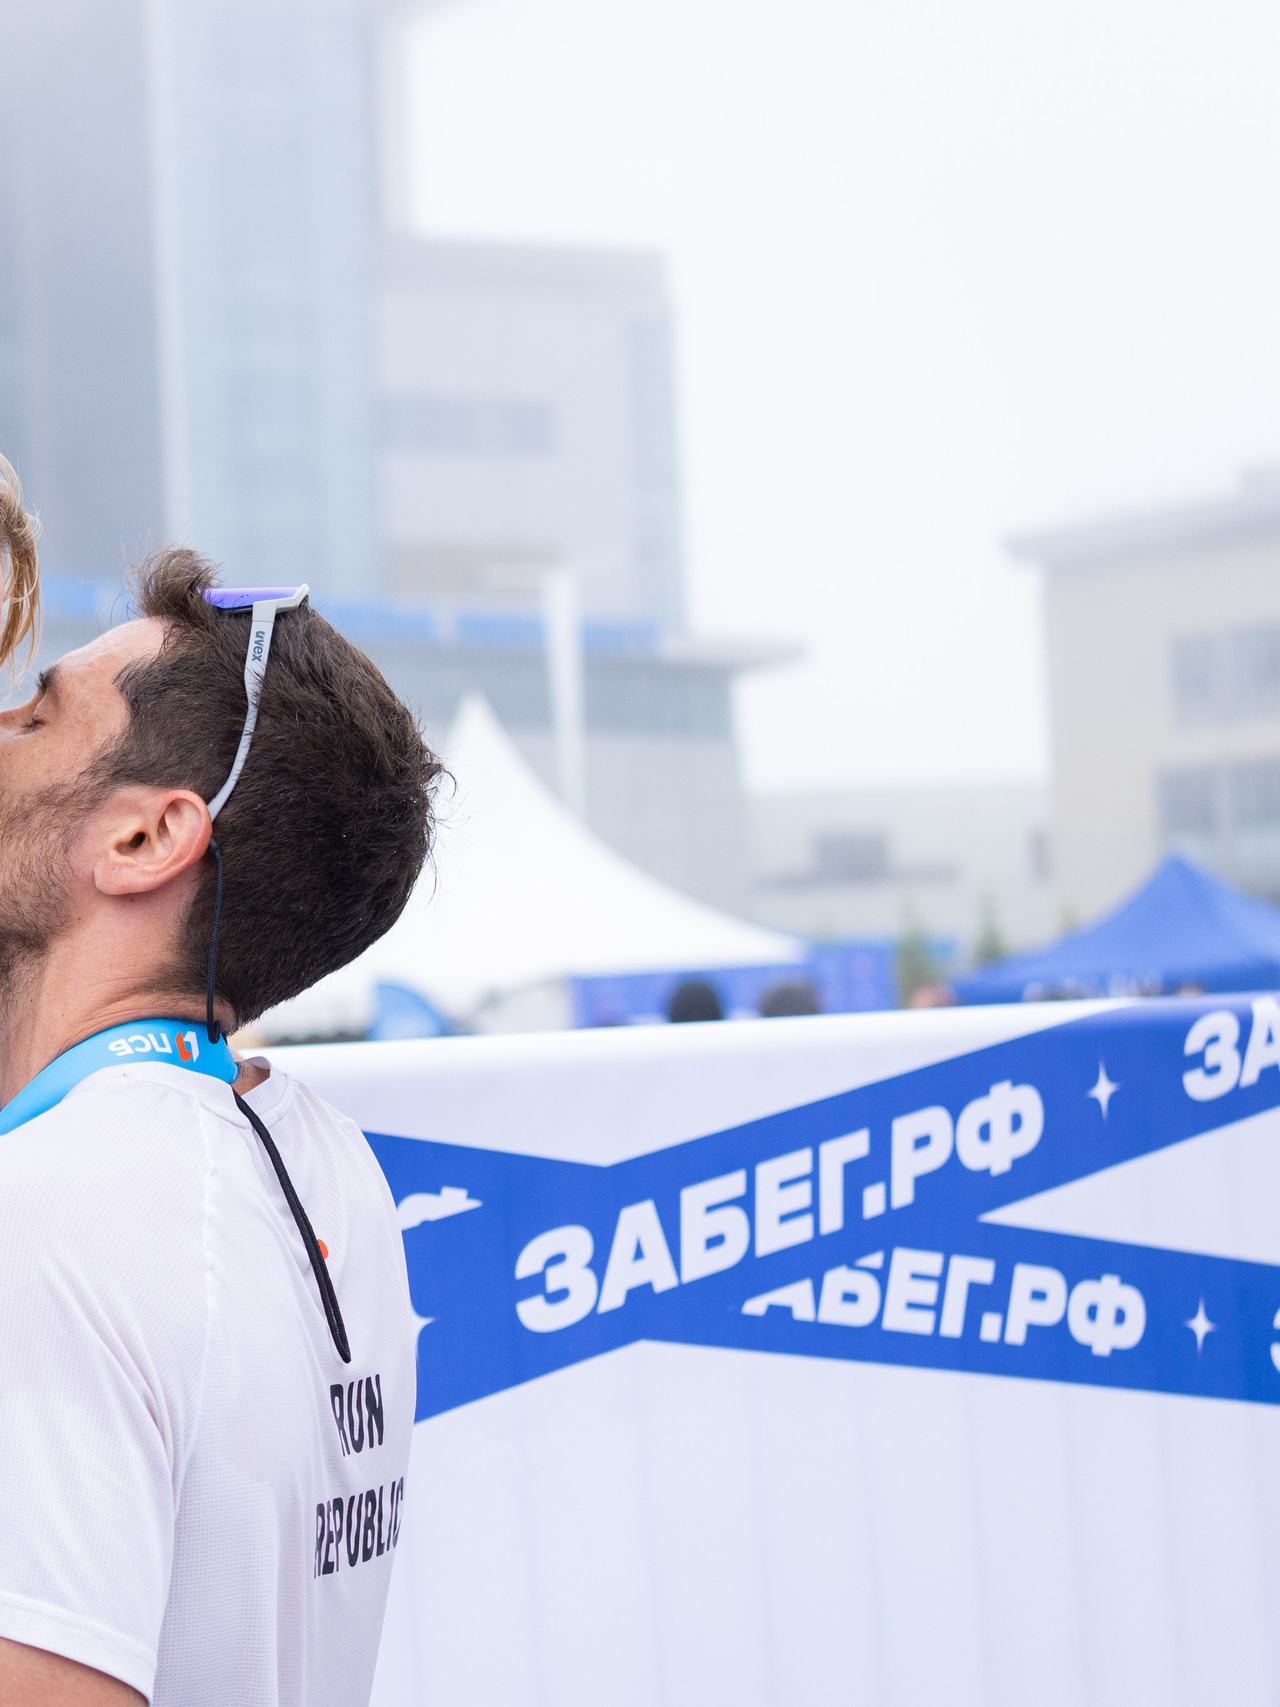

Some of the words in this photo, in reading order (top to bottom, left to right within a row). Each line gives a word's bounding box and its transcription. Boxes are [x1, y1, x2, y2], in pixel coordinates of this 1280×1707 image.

[252, 631, 265, 662] uvex
[108, 1033, 173, 1057] ПСБ
[514, 1079, 1045, 1334] ЗАБЕГ.РФ
[330, 1374, 384, 1457] RUN
[314, 1476, 404, 1579] REPUBLIC
